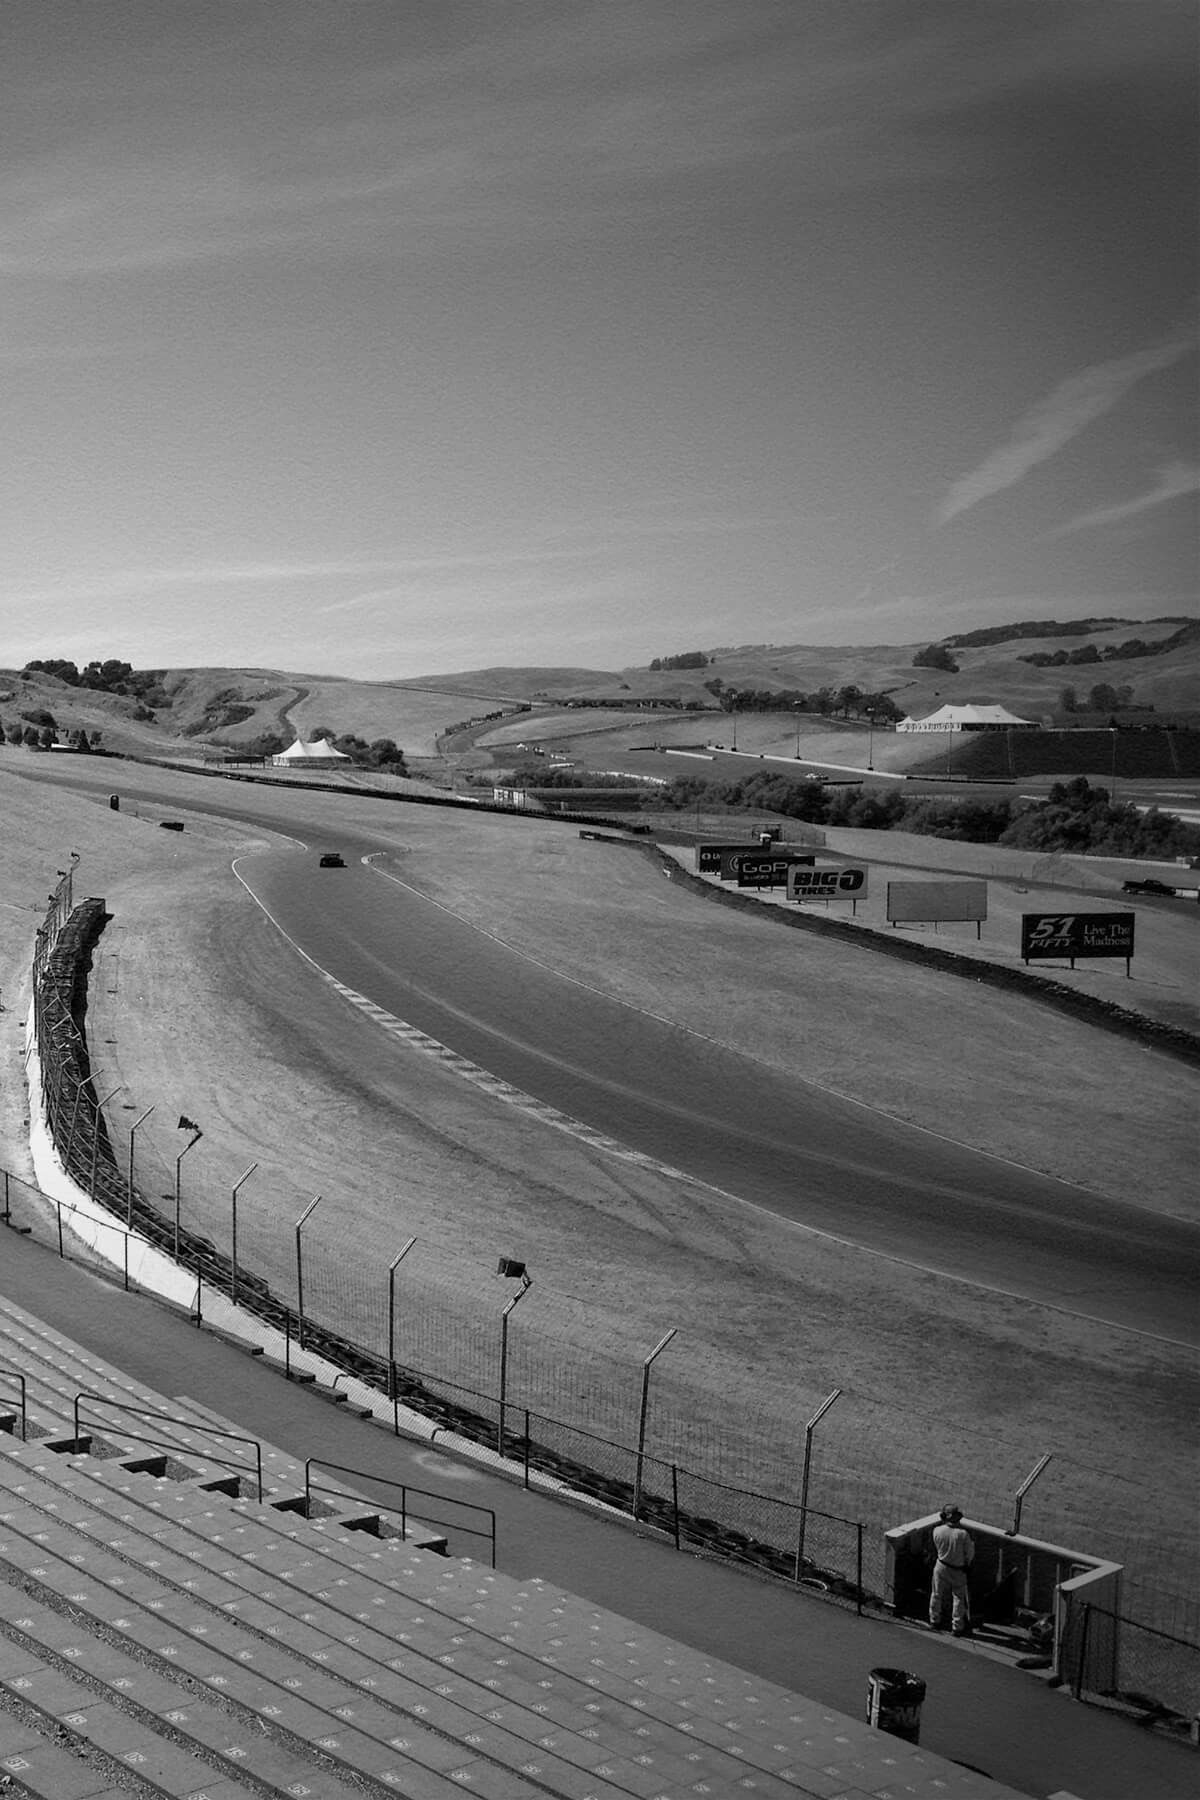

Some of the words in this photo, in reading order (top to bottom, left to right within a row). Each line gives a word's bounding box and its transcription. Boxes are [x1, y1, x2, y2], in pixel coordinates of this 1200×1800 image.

[743, 862, 788, 873] GoP
[794, 872, 839, 886] BIG
[793, 887, 837, 895] TIRES
[1029, 917, 1076, 938] 51
[1084, 924, 1106, 935] Live
[1109, 924, 1130, 936] The
[1029, 937, 1075, 948] FIFTY
[1083, 936, 1130, 945] Madness
